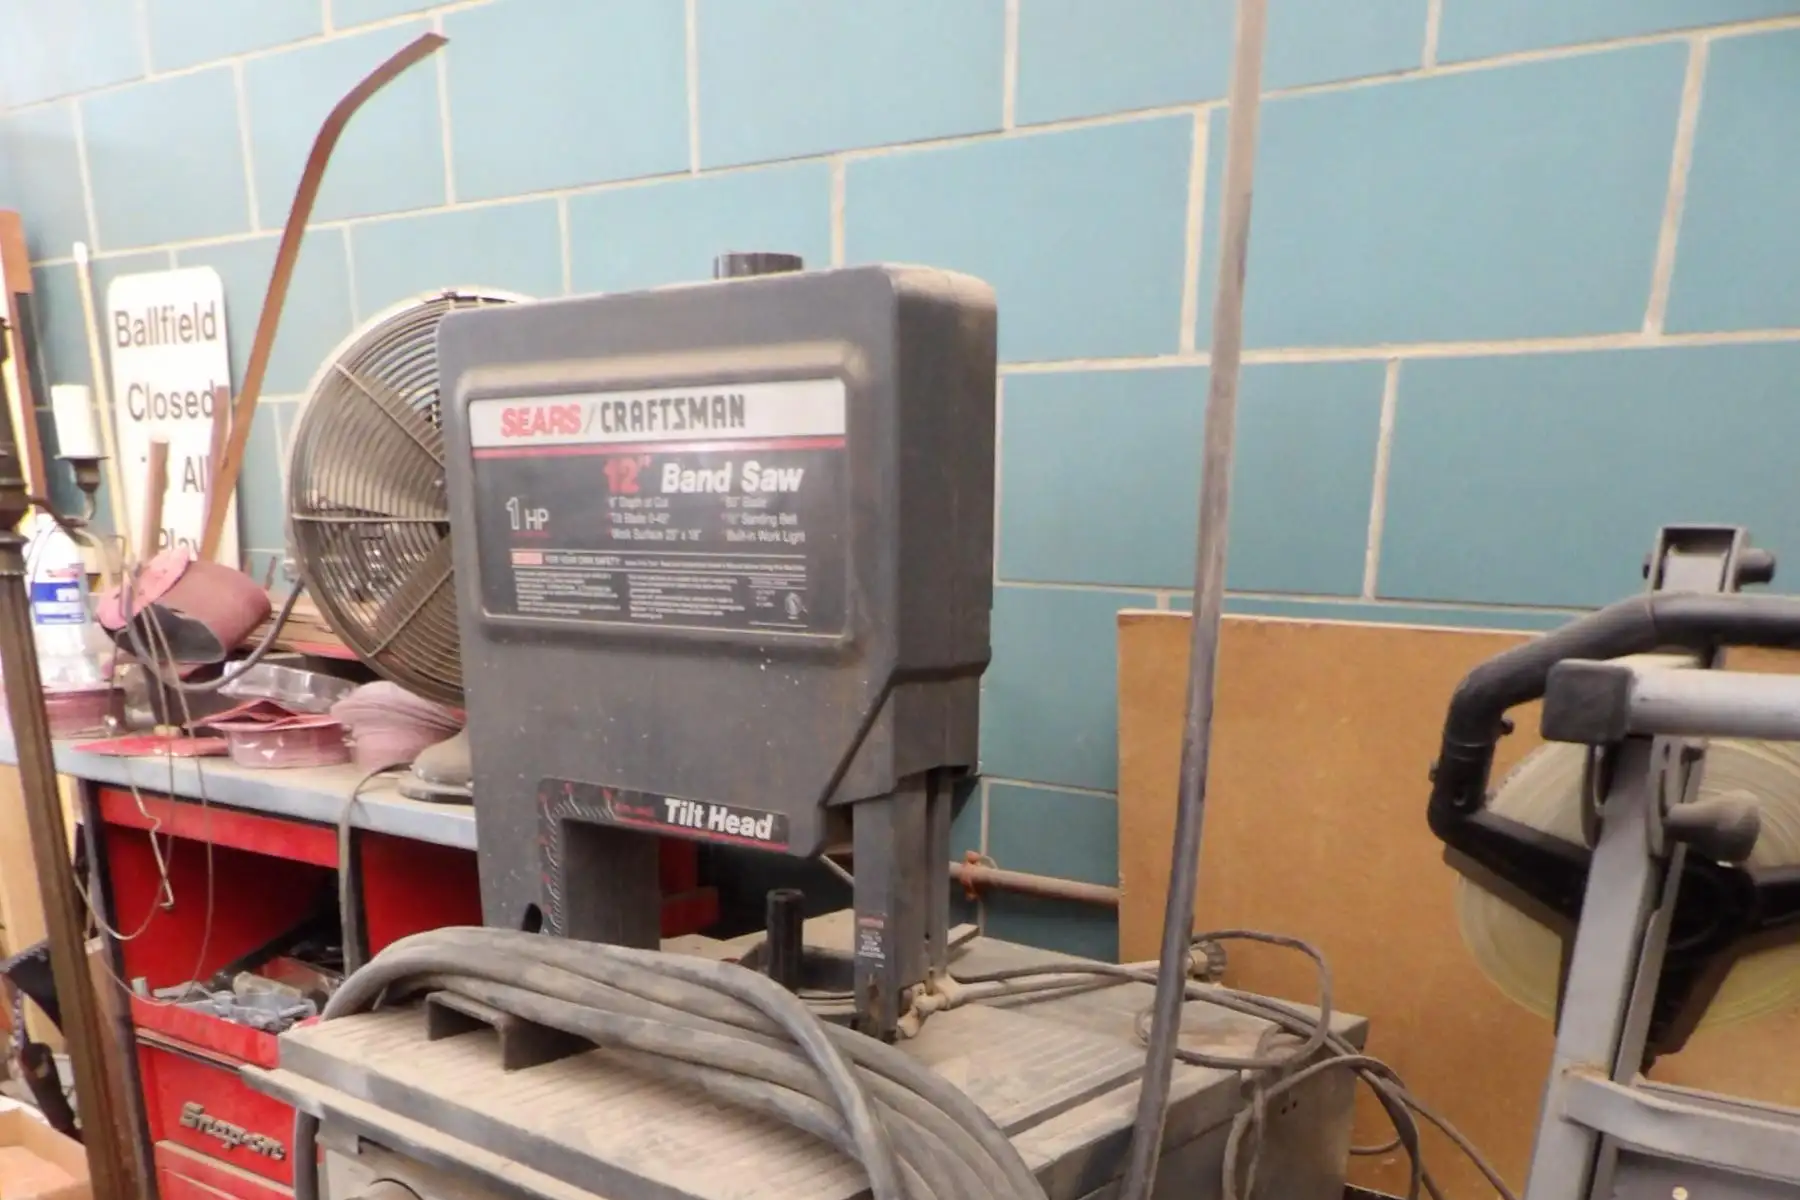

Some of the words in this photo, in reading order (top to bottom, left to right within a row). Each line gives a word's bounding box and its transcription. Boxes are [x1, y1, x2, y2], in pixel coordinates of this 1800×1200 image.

[114, 300, 217, 348] Ballfield
[128, 380, 215, 422] Closed
[501, 404, 582, 437] SEARS
[600, 394, 746, 434] CRAFTSMAN
[661, 461, 731, 494] Band
[741, 461, 803, 493] Saw
[525, 510, 549, 531] HP
[664, 798, 703, 829] Tilt
[707, 809, 774, 841] Head
